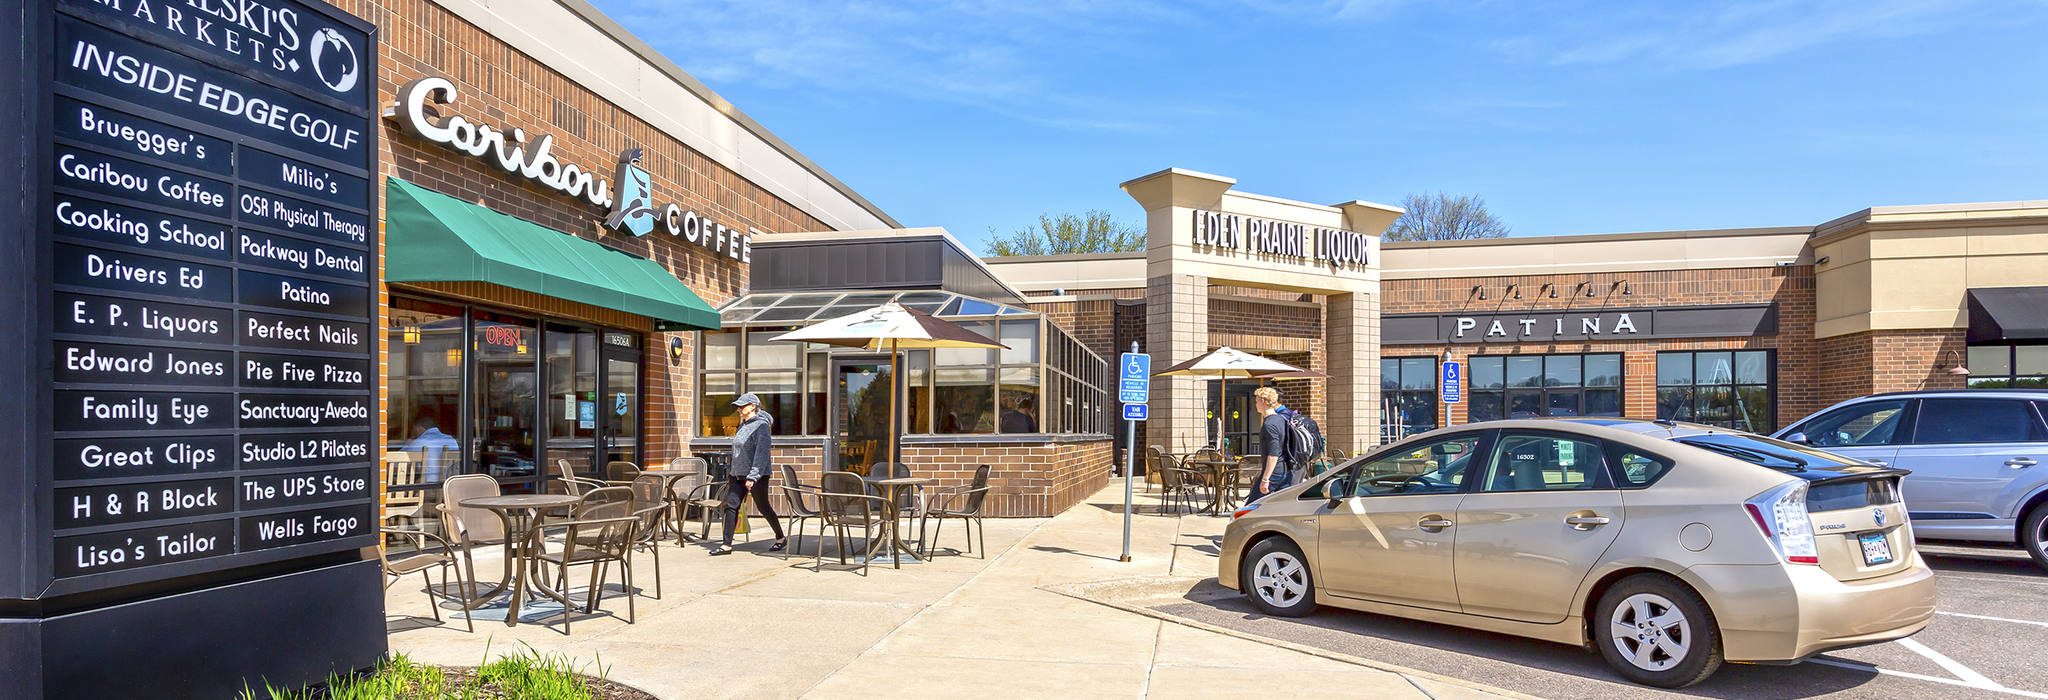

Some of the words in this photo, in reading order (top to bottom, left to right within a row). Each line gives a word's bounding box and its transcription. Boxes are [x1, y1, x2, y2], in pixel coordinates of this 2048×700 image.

[187, 0, 301, 51] LSKI'S
[73, 41, 196, 102] INSIDE
[199, 82, 288, 130] EDGE
[290, 113, 359, 149] GOLF
[81, 108, 206, 160] Bruegger's
[404, 77, 612, 208] Caribou
[60, 154, 147, 191] Caribou
[158, 176, 224, 207] Coffee
[283, 163, 337, 193] Milio's
[57, 202, 148, 244] Cooking
[160, 220, 224, 250] School
[241, 194, 268, 217] OSR
[274, 201, 318, 227] Physical
[323, 212, 364, 242] Therapy
[665, 203, 751, 263] COFFEE
[241, 235, 307, 269] Parkway
[316, 248, 362, 272] Dental
[1193, 210, 1241, 249] EDEN
[1247, 218, 1310, 257] PRAIRIE
[1314, 228, 1370, 266] LIQUOR
[88, 255, 167, 285] Drivers
[180, 267, 203, 289] Ed
[282, 282, 329, 304] Patina
[74, 301, 94, 323] E.
[110, 304, 128, 326] P.
[143, 307, 218, 337] Liquors
[249, 318, 310, 341] Perfect
[320, 325, 358, 345] Nails
[1456, 313, 1637, 338] PATINA
[486, 326, 520, 347] OPEN
[68, 348, 153, 372] Edward
[166, 353, 223, 375] Jones
[247, 360, 273, 380] Pie
[283, 362, 315, 381] Five
[324, 365, 362, 383] Pizza
[84, 397, 158, 424] Family
[172, 398, 209, 424] Eye
[241, 400, 367, 424] Sanctuary-Aveda
[81, 445, 153, 467] Great
[166, 443, 215, 469] Clips
[243, 442, 295, 462] Studio
[301, 440, 317, 458] L2
[322, 440, 366, 457] Pilates
[74, 496, 90, 518] H
[107, 494, 121, 515] &
[137, 491, 148, 512] R
[163, 486, 217, 510] Block
[244, 482, 275, 500] The
[284, 477, 316, 497] UPS
[323, 476, 364, 493] Store
[259, 519, 304, 540] Wells
[314, 516, 357, 535] Fargo
[77, 538, 145, 568] Lisa's
[157, 533, 217, 557] Tailor
